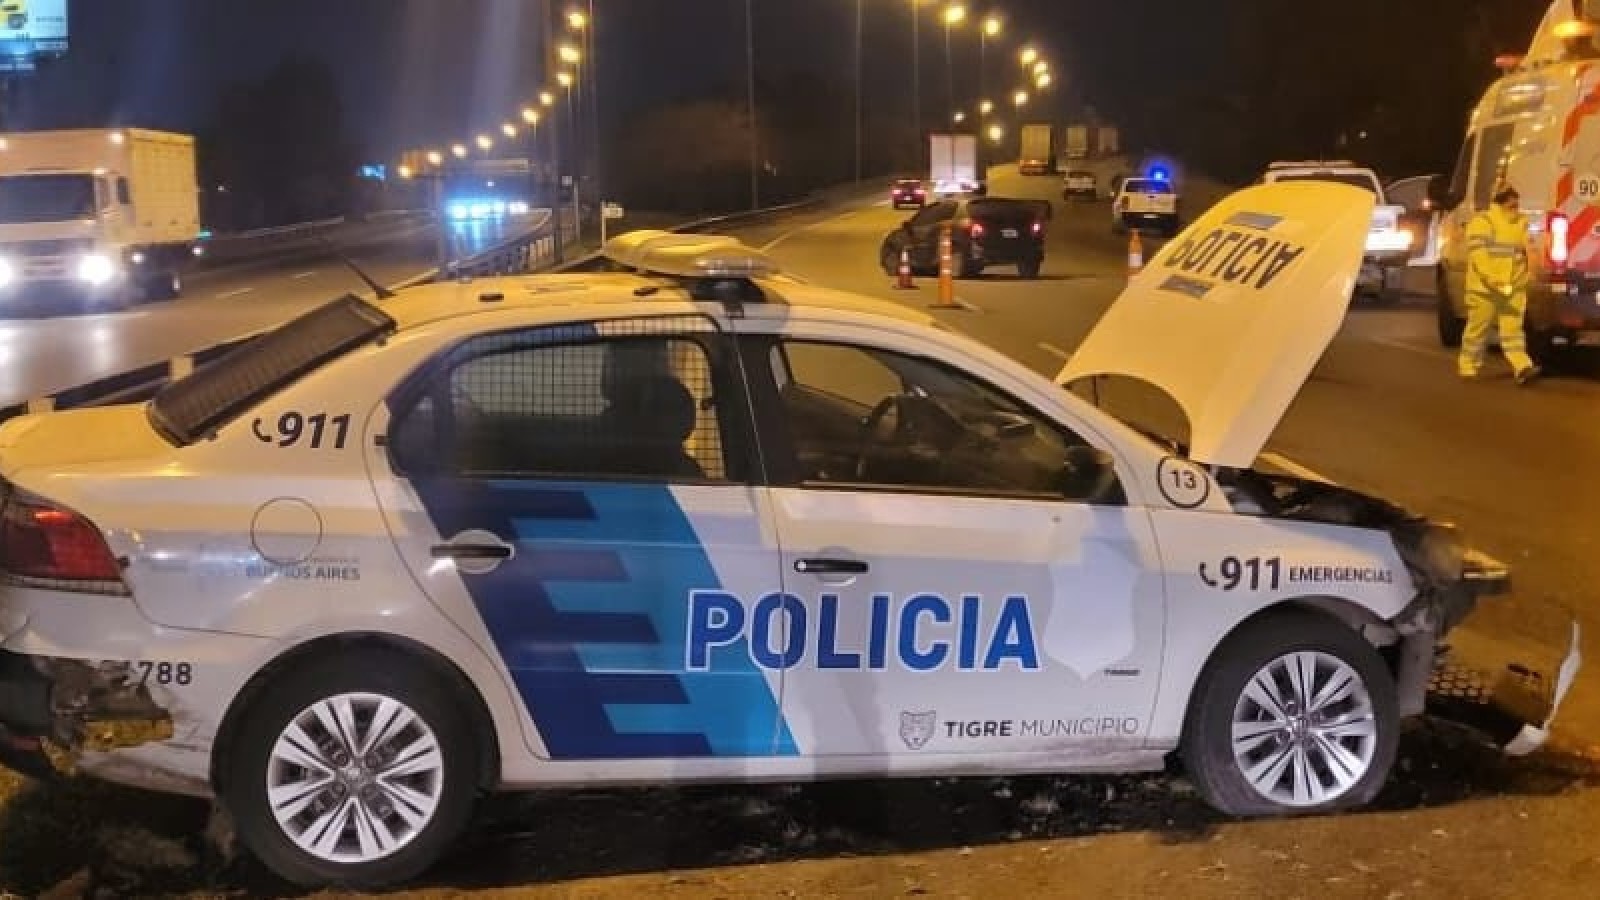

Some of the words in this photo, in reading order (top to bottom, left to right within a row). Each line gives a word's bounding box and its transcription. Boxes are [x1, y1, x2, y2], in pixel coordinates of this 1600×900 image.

[278, 411, 351, 448] 911
[1170, 469, 1196, 489] 13
[315, 565, 362, 581] AIRES
[1219, 556, 1281, 591] 911
[1289, 566, 1393, 584] EMERGENCIAS
[686, 590, 1041, 671] POLICIA
[121, 660, 193, 686] 788
[944, 720, 1013, 737] TIGRE
[1018, 717, 1140, 737] MUNICIPIO
